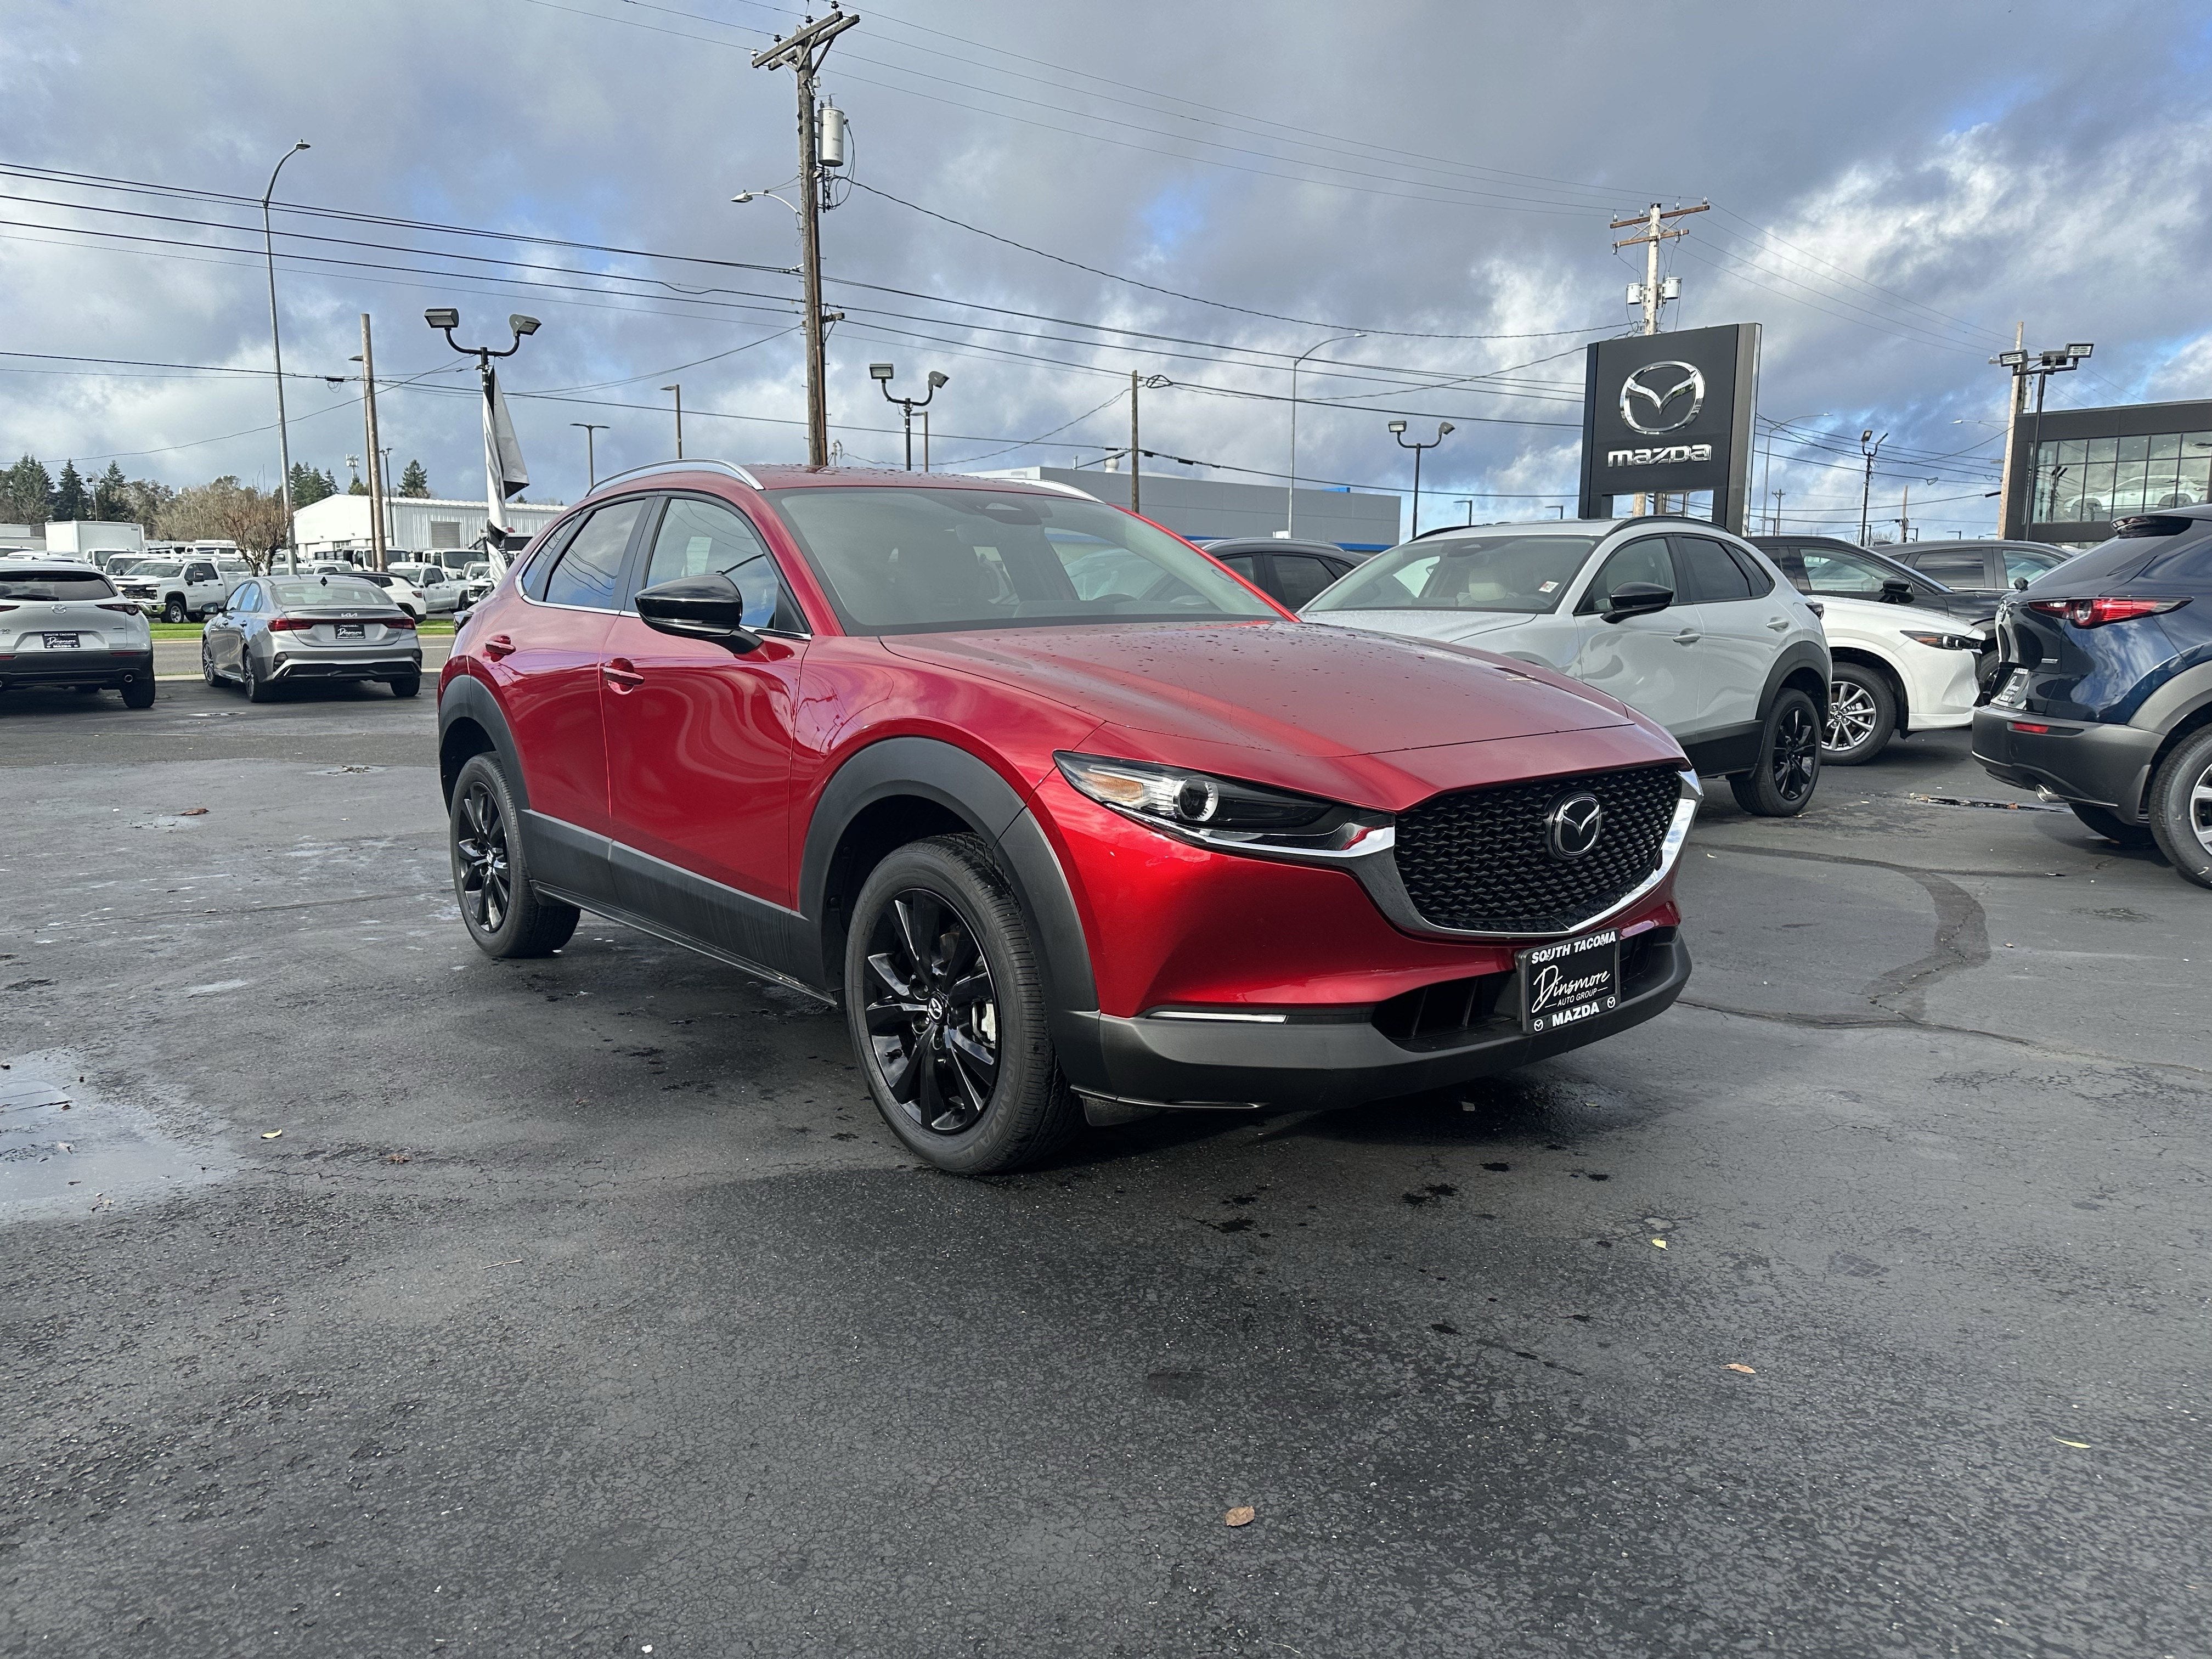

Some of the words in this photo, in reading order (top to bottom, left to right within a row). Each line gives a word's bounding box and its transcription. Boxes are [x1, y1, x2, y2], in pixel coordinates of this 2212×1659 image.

[1531, 943, 1571, 964] SOUTH
[1573, 931, 1616, 953] TACOMA
[1531, 964, 1611, 1014] Dinsmore
[1557, 996, 1575, 1007] AUTO
[1576, 988, 1598, 1002] GROUP
[1552, 1001, 1600, 1027] MAZDA
